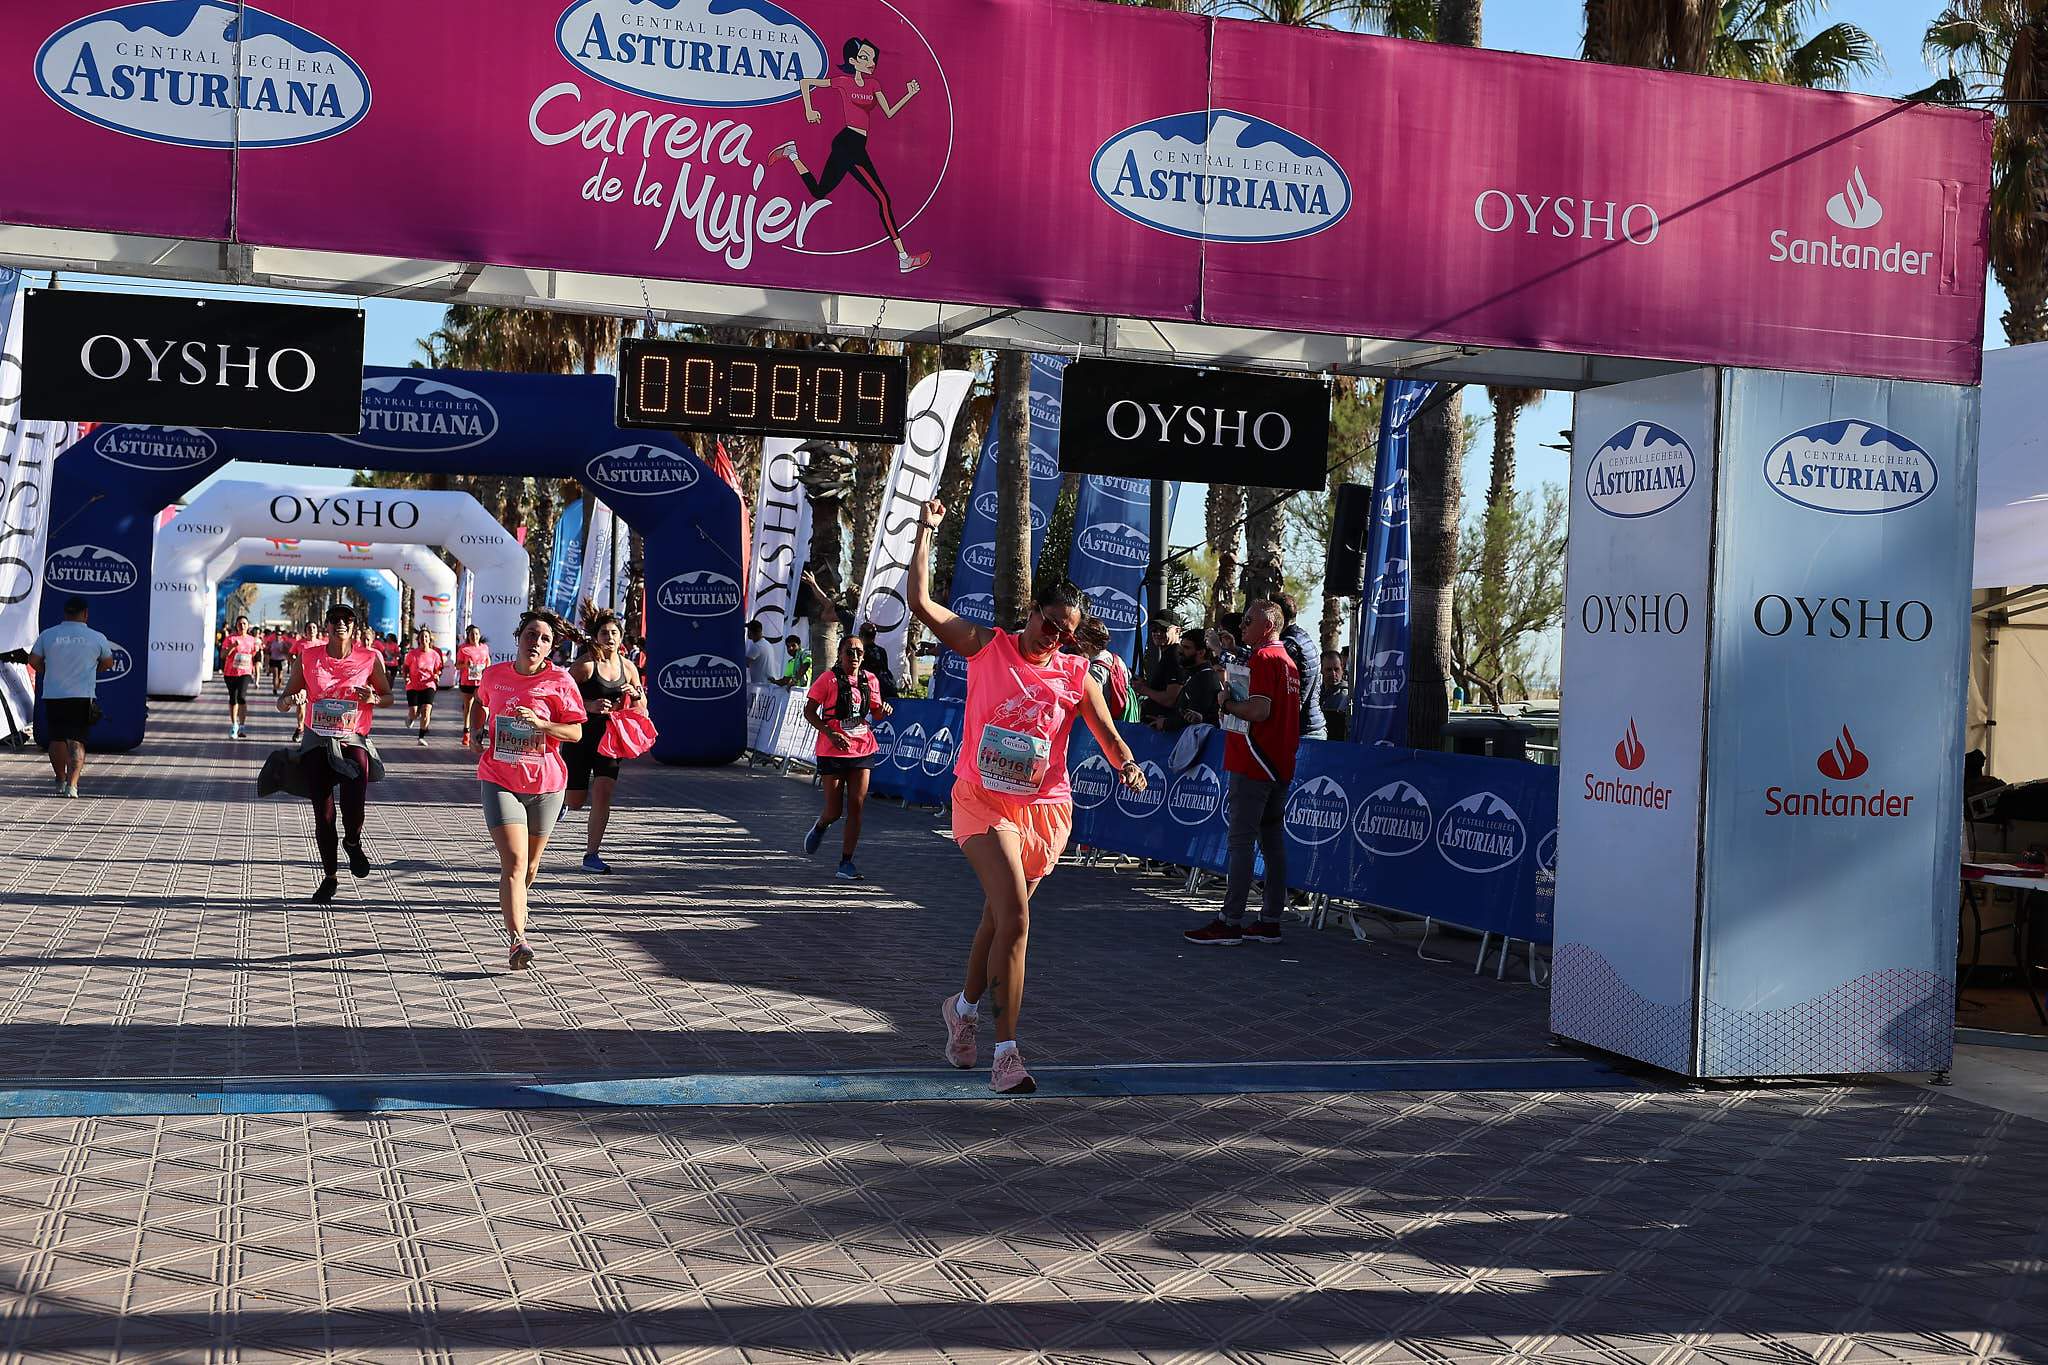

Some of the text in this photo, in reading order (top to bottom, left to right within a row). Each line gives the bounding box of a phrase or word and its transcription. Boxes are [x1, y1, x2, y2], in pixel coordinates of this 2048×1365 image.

[621, 13, 800, 44] CENTRAL LECHERA
[117, 41, 337, 76] CENTRAL LECHERA
[577, 12, 805, 82] ASTURIANA
[61, 41, 346, 119] ASTURIANA
[528, 82, 752, 167] Carrera
[1153, 149, 1325, 177] CENTRAL LECHERA
[1111, 149, 1332, 216] ASTURIANA
[582, 157, 833, 271] de la Mujer
[1474, 189, 1660, 246] OYSHO
[1769, 229, 1934, 275] Santander
[80, 334, 316, 392] OYSHO
[364, 396, 415, 407] ENTRAL
[640, 355, 886, 425] 00:38:04
[1106, 400, 1292, 451] OYSHO
[101, 433, 207, 459] ASTURIANA
[1609, 451, 1684, 467] CENTRAL LECHERA
[1804, 450, 1920, 467] CENTRAL LECHERA
[596, 463, 693, 483] ASTURIANA
[1593, 460, 1687, 497] ASTURIANA
[1776, 450, 1924, 494] ASTURIANA
[177, 523, 224, 535] OYSHO
[270, 494, 420, 530] OYSHO
[866, 409, 946, 634] OYSHO
[460, 534, 505, 545] OYSHO
[47, 561, 131, 584] ASTURIANA
[154, 583, 198, 593] OYSHO
[481, 594, 522, 605] OYSHO
[662, 587, 738, 605] ASTURIANA
[1582, 592, 1689, 635] OYSHO
[1753, 593, 1933, 642] OYSHO
[151, 641, 194, 652] OYSHO
[663, 671, 739, 689] ASTURIANA
[1171, 783, 1216, 812] ASTURIANA
[1583, 773, 1672, 811] Santander
[1765, 785, 1914, 818] Santander
[1286, 798, 1342, 830] ASTURIANA
[1357, 805, 1425, 842] ASTURIANA
[1440, 815, 1515, 858] ASTURIANA
